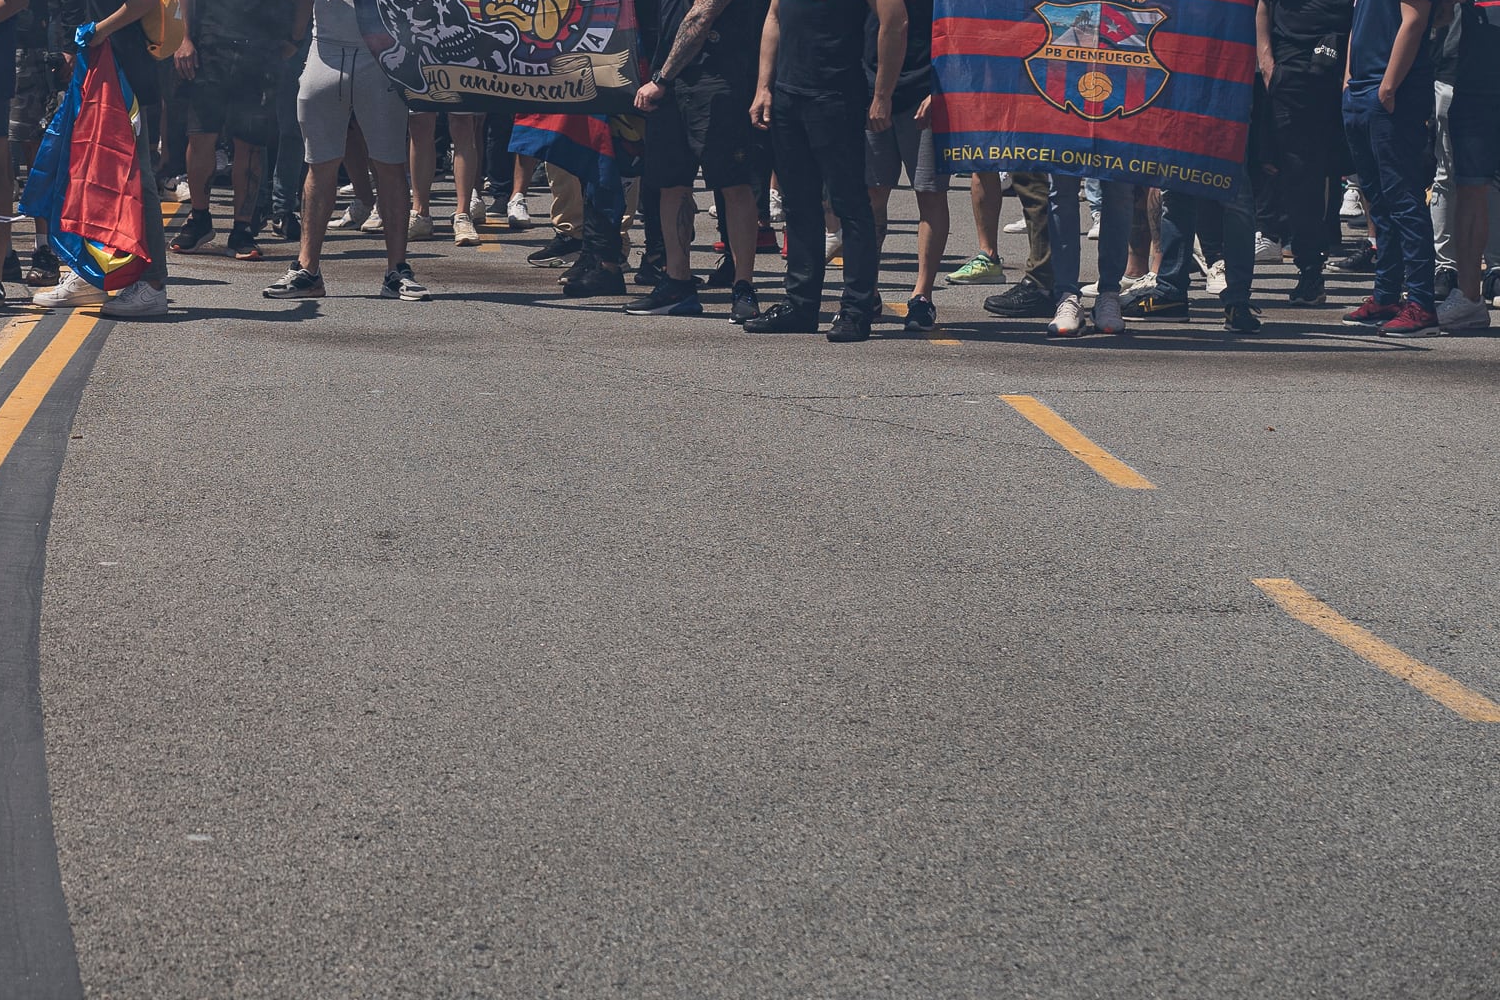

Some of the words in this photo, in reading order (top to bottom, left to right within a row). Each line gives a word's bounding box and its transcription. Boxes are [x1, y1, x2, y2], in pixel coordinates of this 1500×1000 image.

[1044, 47, 1062, 58] PB
[1065, 48, 1151, 65] CIENFUEGOS
[426, 68, 450, 91] 40
[459, 69, 588, 101] aniversari
[943, 144, 984, 161] PEÑA
[988, 146, 1124, 171] BARCELONISTA
[1127, 159, 1233, 190] CIENFUEGOS
